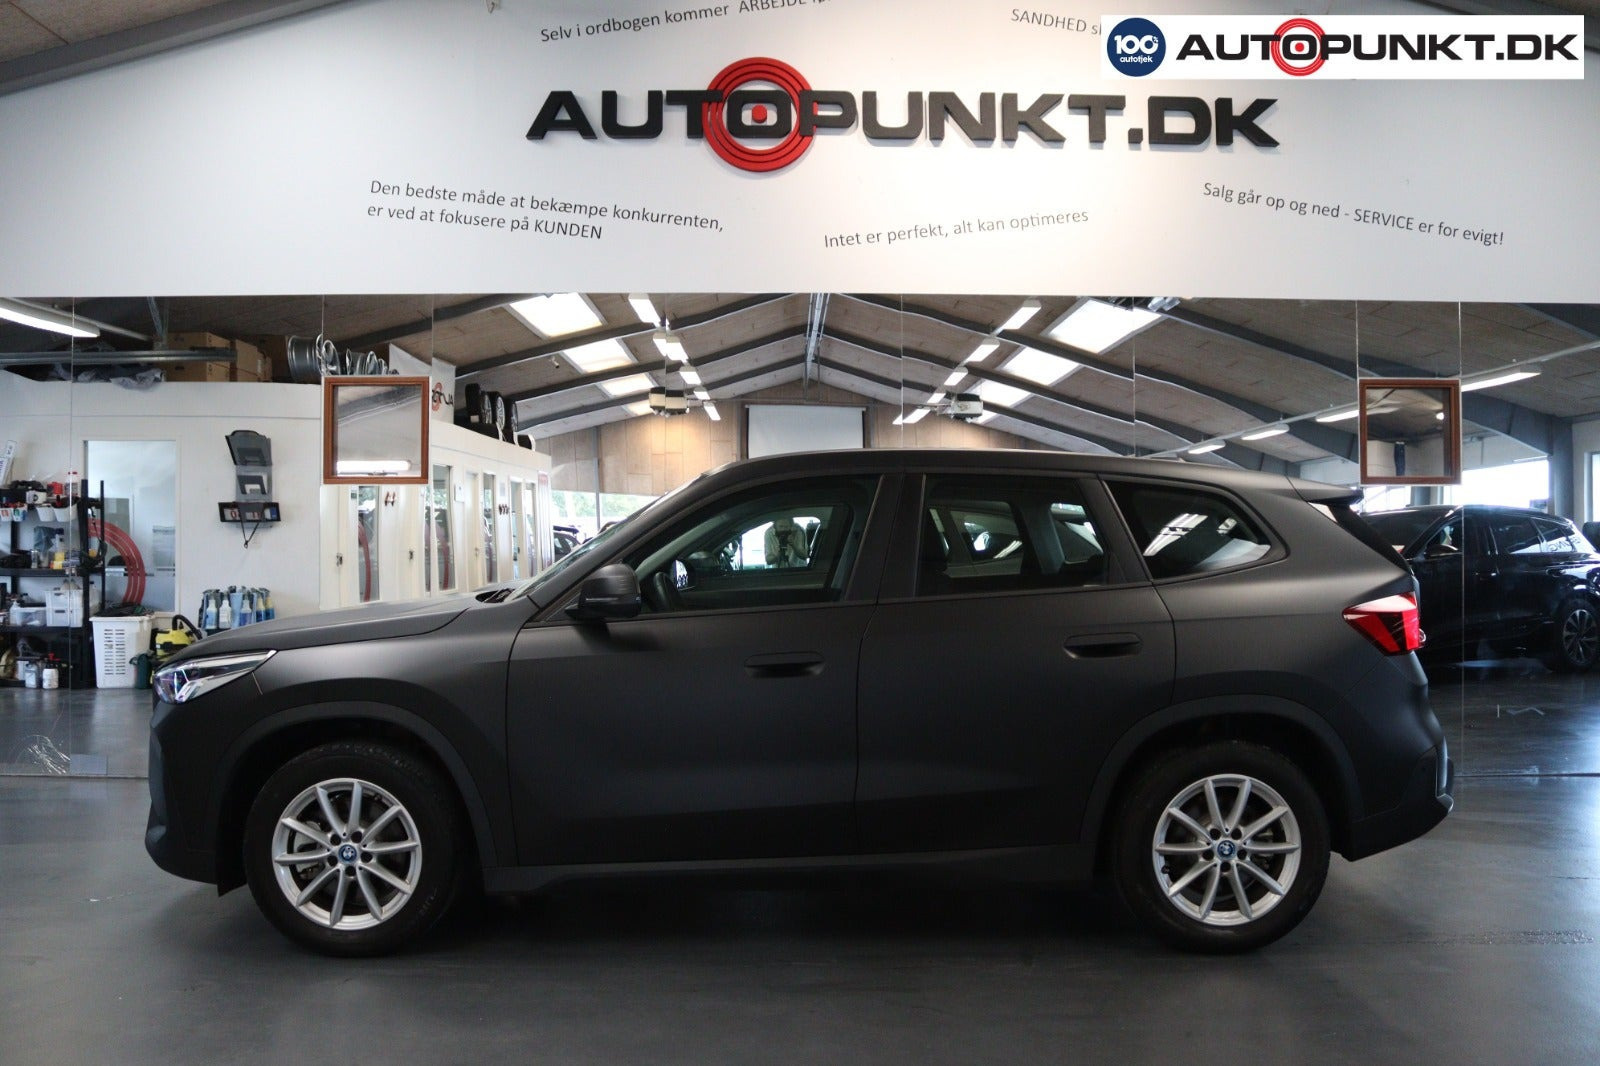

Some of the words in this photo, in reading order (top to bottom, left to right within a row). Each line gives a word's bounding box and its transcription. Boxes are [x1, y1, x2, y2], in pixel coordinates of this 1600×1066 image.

[541, 26, 571, 42] Selv
[576, 23, 581, 37] i
[586, 16, 660, 35] ordbogen
[665, 6, 729, 23] kommer
[1011, 9, 1087, 32] SANDHED
[526, 90, 1280, 147] AUTOPUNKT.DK
[368, 206, 383, 216] er
[388, 207, 415, 220] ved
[420, 210, 434, 221] at
[440, 209, 505, 228] fokusere
[511, 216, 529, 232] på
[535, 220, 602, 239] KUNDEN
[370, 180, 400, 195] Den
[406, 183, 456, 201] bedste
[462, 190, 505, 206] måde
[510, 196, 525, 208] at
[531, 196, 607, 218] bekæmpe
[613, 205, 723, 232] konkurrenten,
[1204, 183, 1233, 202] Salg
[1238, 190, 1262, 205] går
[1266, 197, 1284, 211] op
[1290, 201, 1307, 215] og
[1312, 205, 1340, 218] ned
[1354, 209, 1414, 230] SERVICE
[1419, 223, 1434, 233] er
[1438, 222, 1459, 237] for
[1463, 230, 1504, 246] evigt!
[825, 233, 861, 248] Intet
[866, 233, 882, 243] er
[888, 224, 948, 245] perfekt,
[954, 220, 973, 234] alt
[978, 219, 1004, 232] kan
[1010, 211, 1089, 231] optimeres
